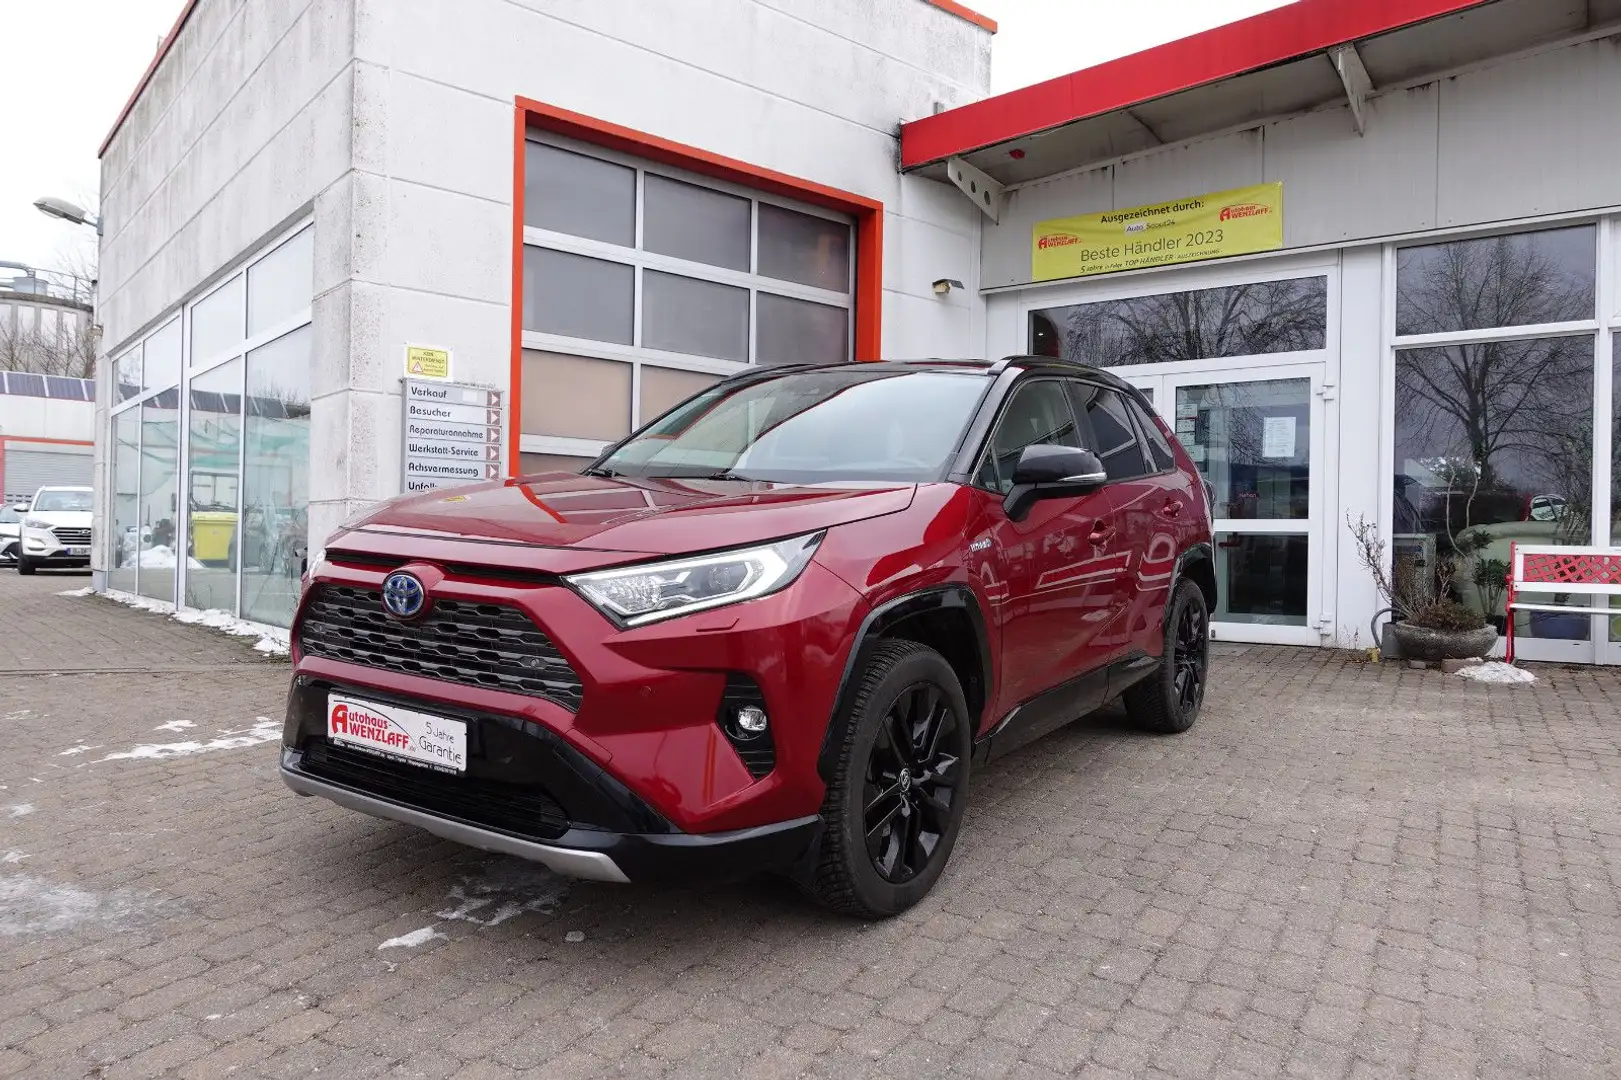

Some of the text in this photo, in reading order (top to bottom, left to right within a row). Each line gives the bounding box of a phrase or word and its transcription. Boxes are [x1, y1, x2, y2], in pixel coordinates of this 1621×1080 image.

[1100, 199, 1205, 224] Ausgezeichnet durch:
[1080, 228, 1224, 262] Beste Händler 2023
[1124, 259, 1139, 267] TOP
[411, 386, 448, 399] Verkauf
[410, 405, 452, 418] Besucher
[409, 424, 484, 439] Reparaturannahme
[408, 443, 479, 457] Werkstatt-Service
[408, 461, 479, 478] Achsvermessung
[348, 721, 410, 750] WENZLAFF
[425, 721, 455, 744] 5 Jahre
[419, 735, 462, 765] Garantie
